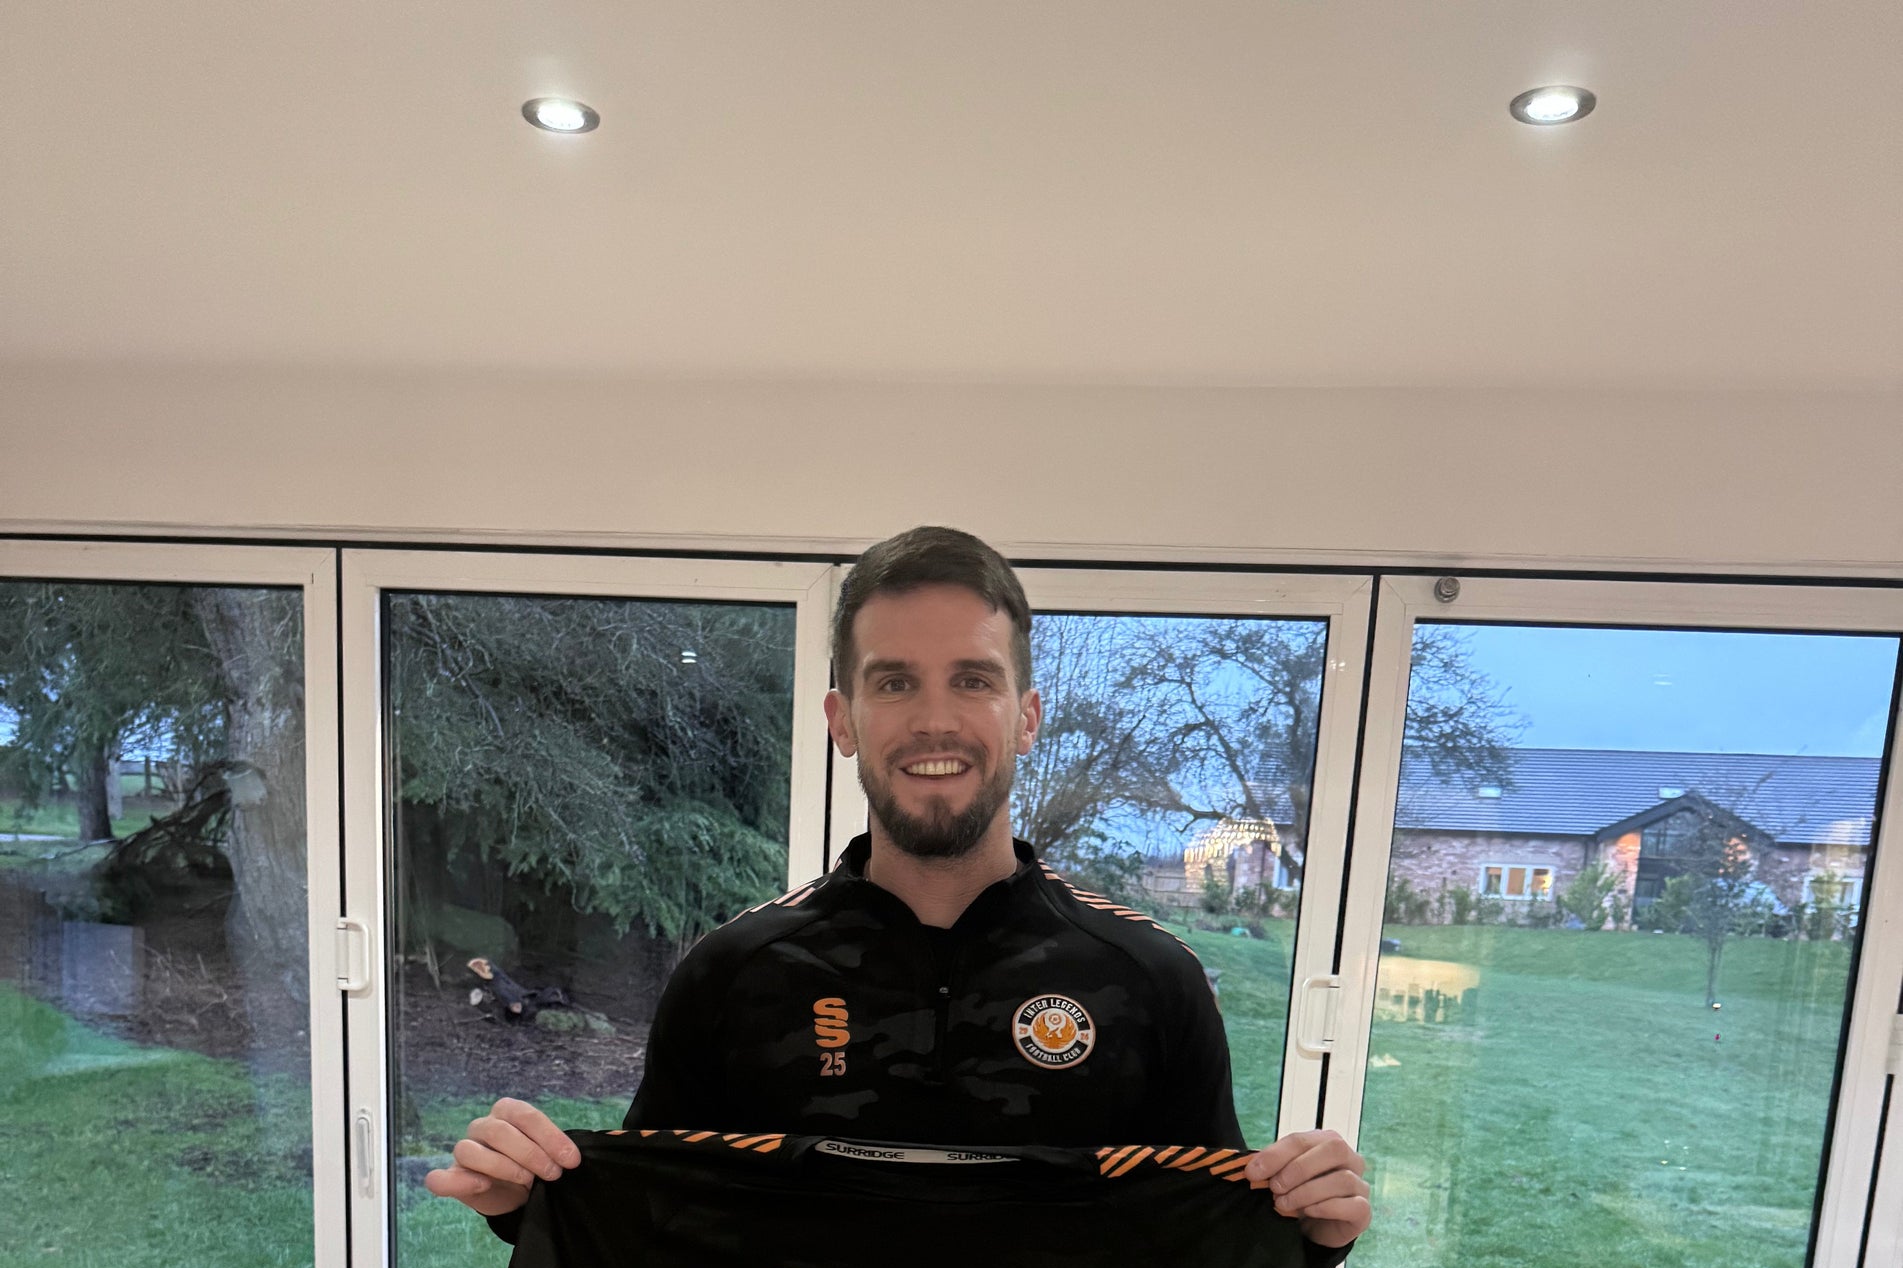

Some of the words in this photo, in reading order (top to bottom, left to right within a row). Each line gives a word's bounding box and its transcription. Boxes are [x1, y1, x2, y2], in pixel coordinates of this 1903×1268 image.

[1023, 1000, 1049, 1019] INTER
[1050, 998, 1086, 1023] LEGENDS
[1025, 1043, 1062, 1063] FOOTBALL
[1062, 1047, 1081, 1061] CLUB
[819, 1051, 847, 1077] 25
[825, 1142, 905, 1160] SURRIDGE
[946, 1152, 1010, 1161] SURRID
